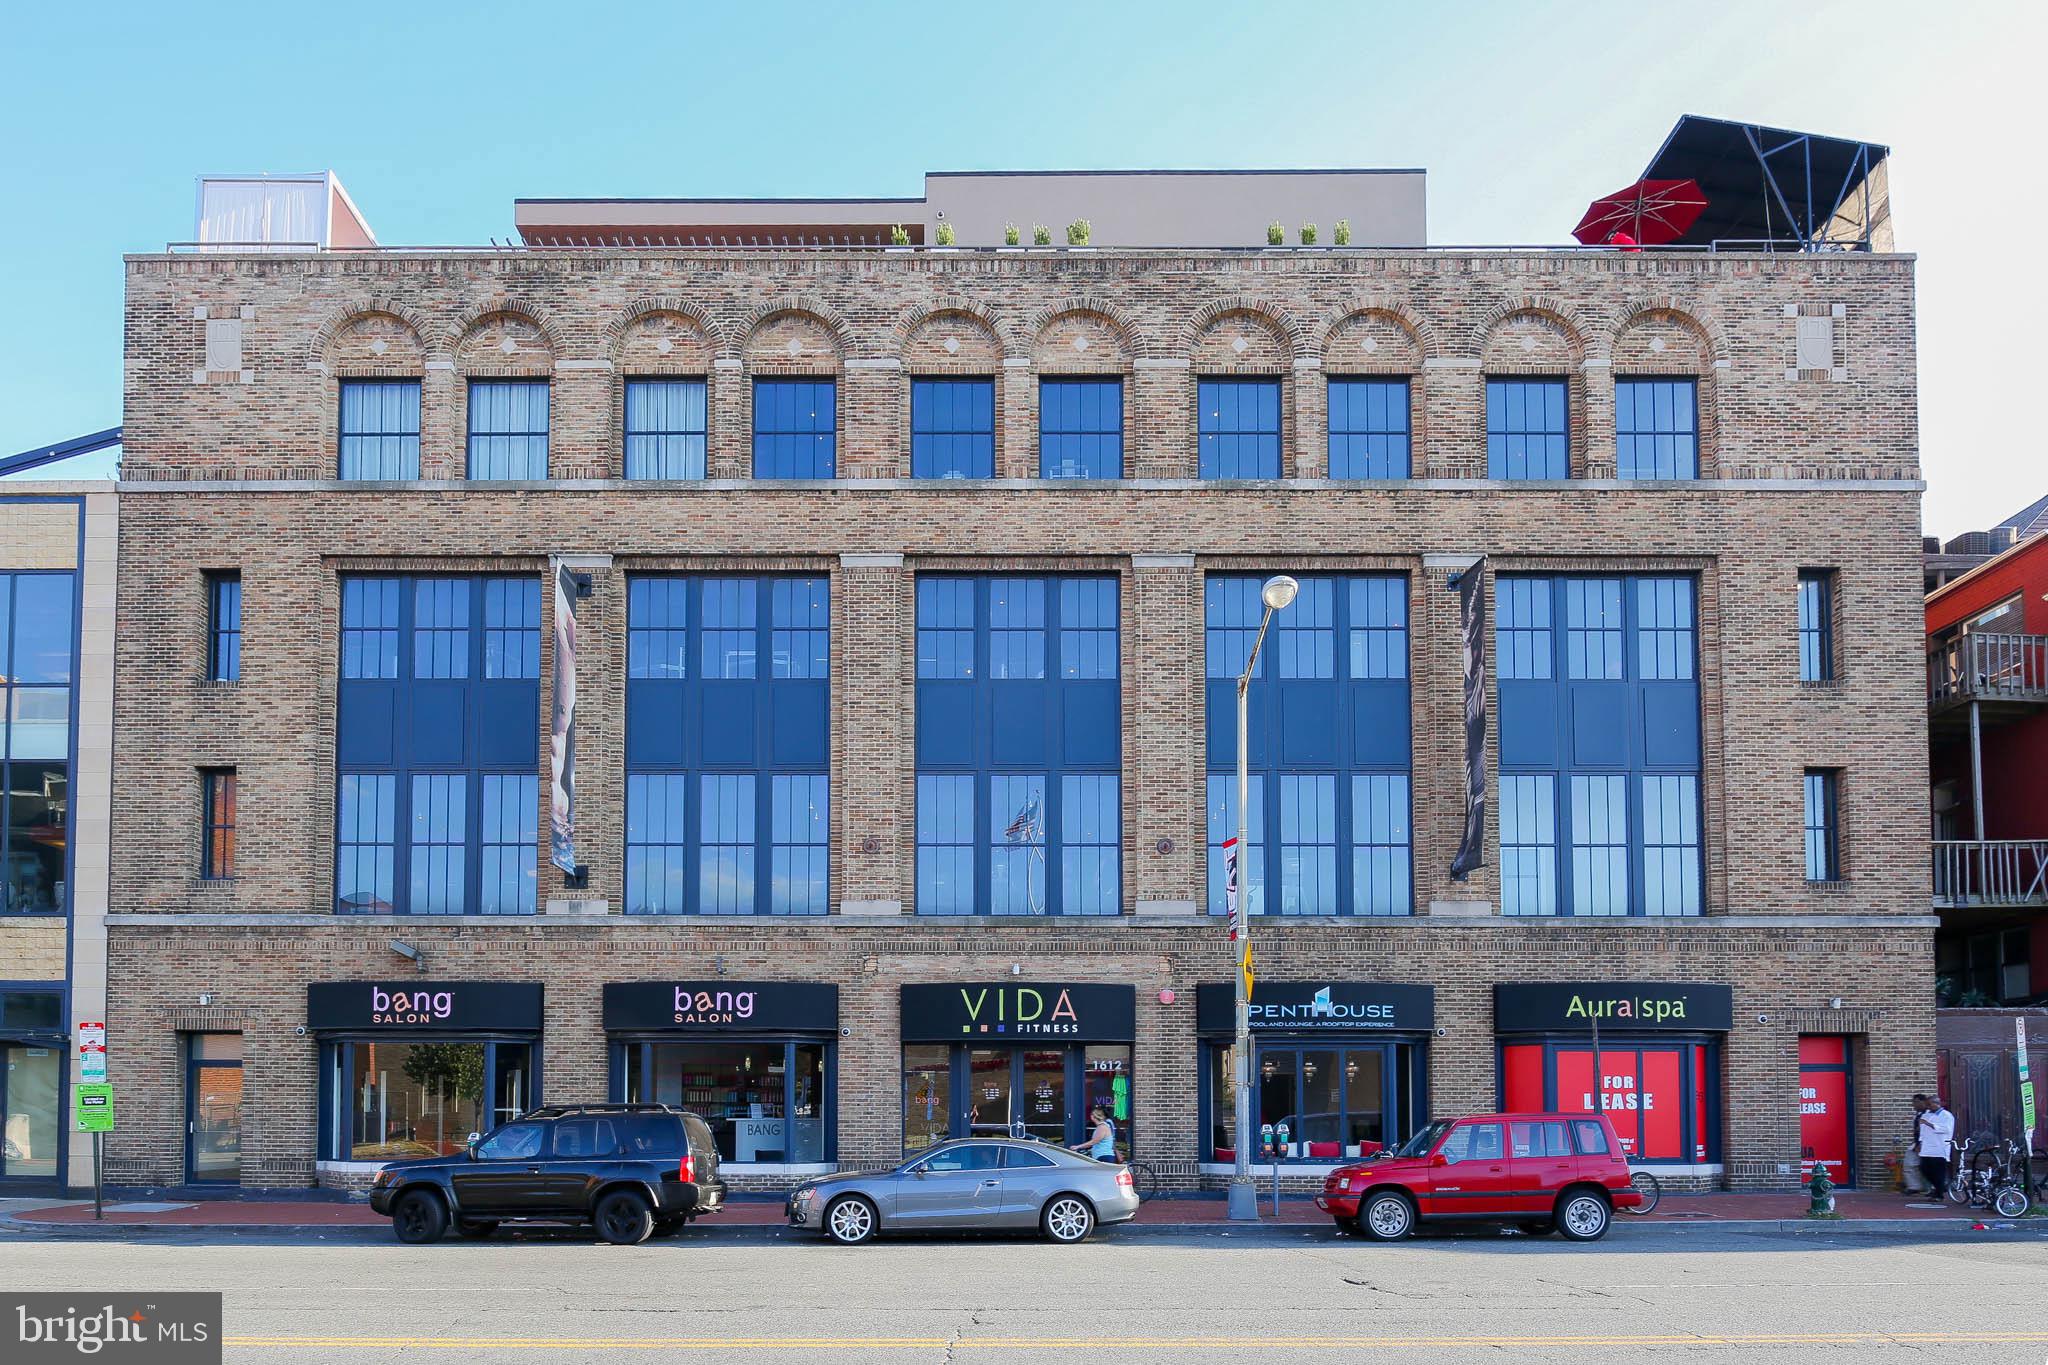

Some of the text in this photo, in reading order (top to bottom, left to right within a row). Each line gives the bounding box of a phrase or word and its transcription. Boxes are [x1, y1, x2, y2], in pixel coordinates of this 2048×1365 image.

[373, 986, 451, 1018] bang
[674, 986, 753, 1018] bang
[960, 988, 1077, 1021] VIDA
[1248, 996, 1394, 1018] PENTHOUSE
[373, 1014, 429, 1023] SALON
[674, 1014, 732, 1023] SALON
[1017, 1024, 1078, 1033] FITNESS
[1093, 1060, 1122, 1070] 1612
[1603, 1076, 1634, 1089] FOR
[915, 1096, 940, 1105] bang
[1583, 1093, 1654, 1110] LEASE
[747, 1124, 781, 1136] BANG
